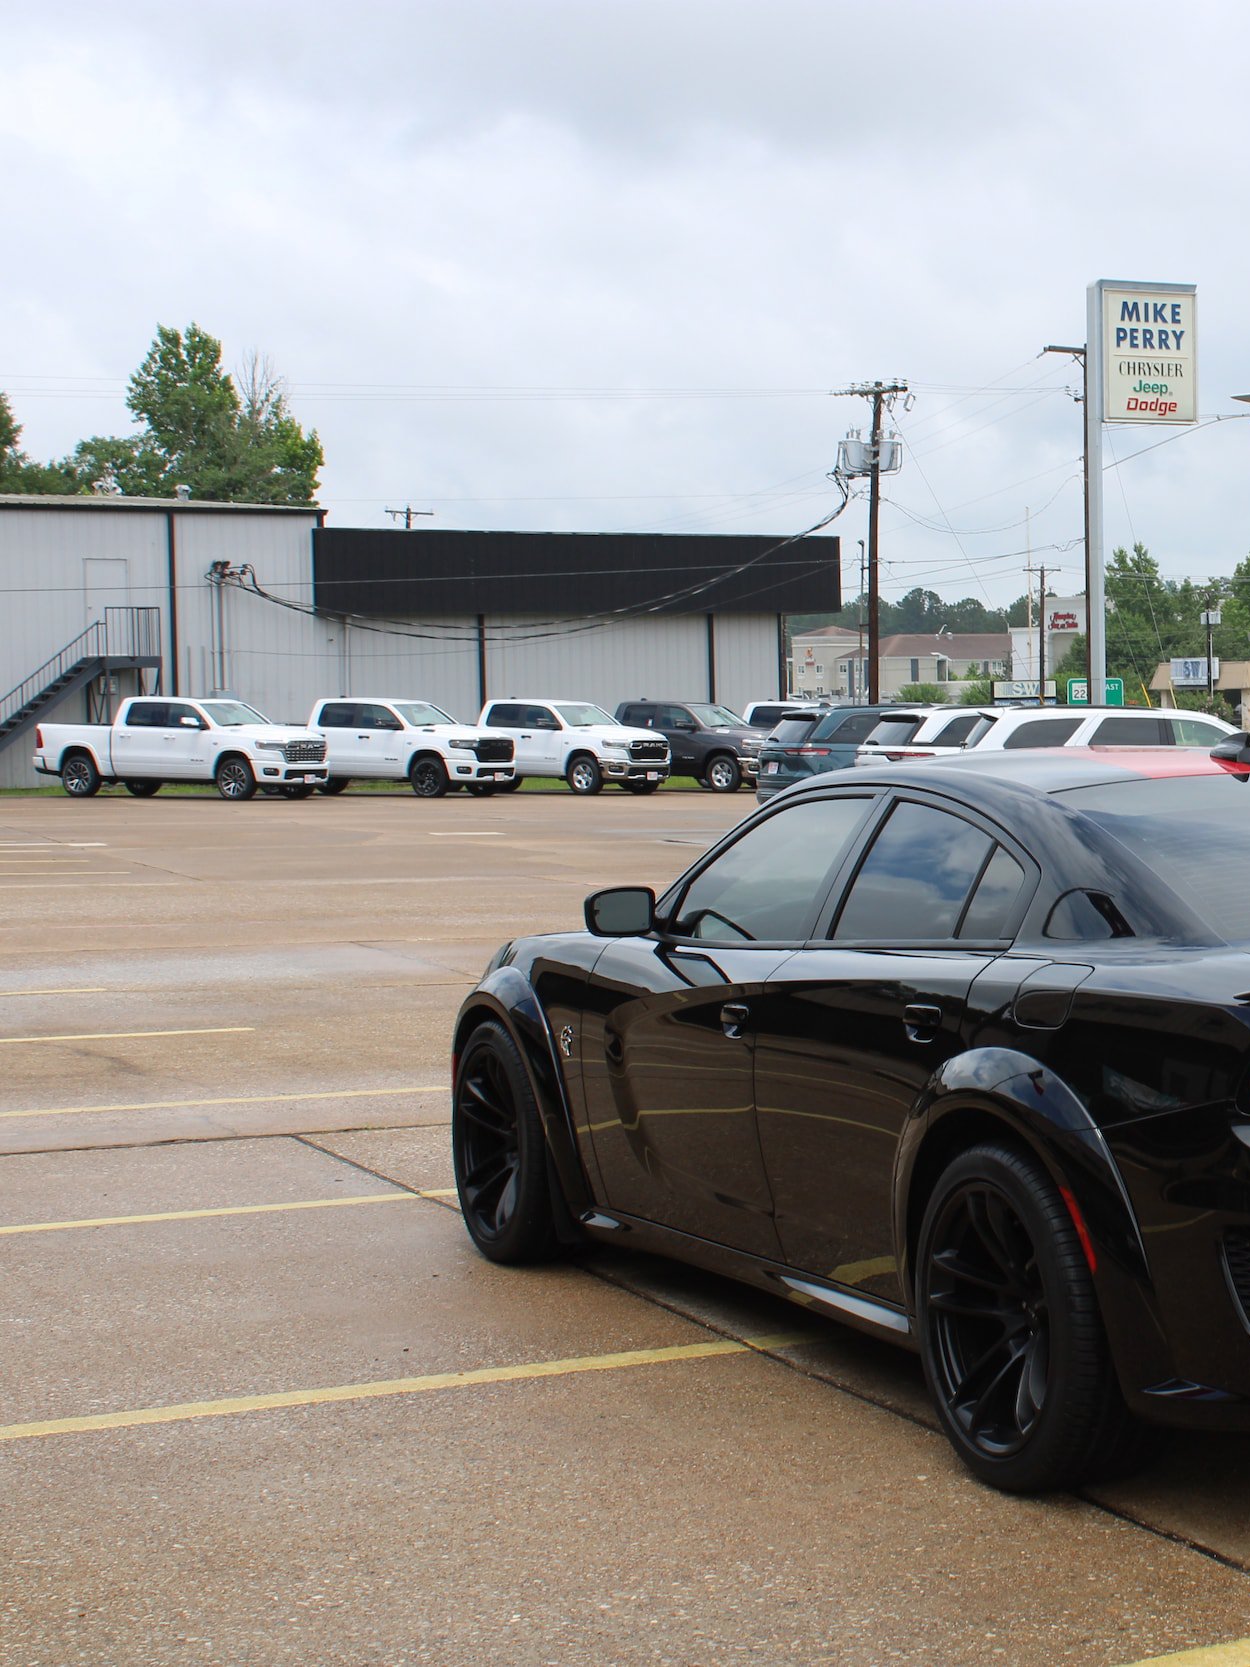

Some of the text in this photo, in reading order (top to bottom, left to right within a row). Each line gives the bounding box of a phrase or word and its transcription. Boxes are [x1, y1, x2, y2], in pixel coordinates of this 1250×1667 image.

[1120, 301, 1182, 324] MIKE
[1116, 327, 1186, 350] PERRY
[1119, 360, 1184, 378] CHRYSLER
[1133, 380, 1169, 396] Jeep
[1126, 397, 1178, 416] Dodge
[1012, 681, 1040, 696] SW
[1073, 683, 1119, 699] 22 AST
